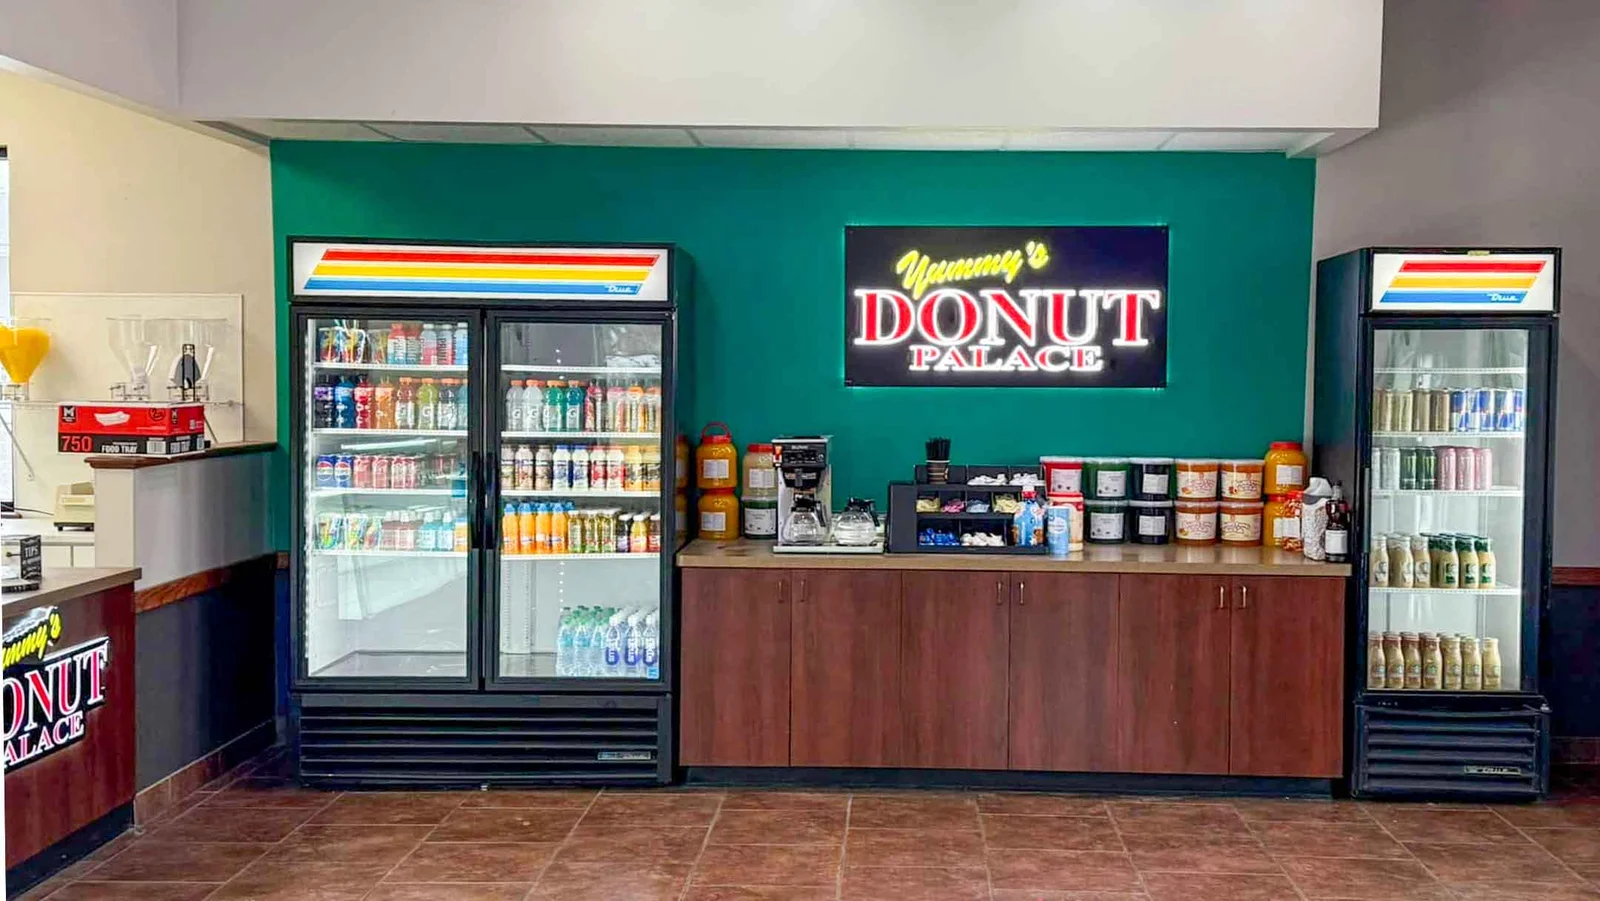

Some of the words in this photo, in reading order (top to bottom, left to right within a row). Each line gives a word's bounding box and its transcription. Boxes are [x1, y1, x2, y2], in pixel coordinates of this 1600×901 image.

[896, 241, 1049, 300] Yummy's
[854, 288, 1161, 346] DONUT
[909, 345, 1104, 371] PALACE
[61, 436, 93, 452] 750
[101, 444, 120, 453] FOOD
[121, 445, 138, 453] TRAY
[25, 545, 38, 558] TIPS
[3, 641, 109, 742] ONUT
[3, 710, 85, 768] ALACE
